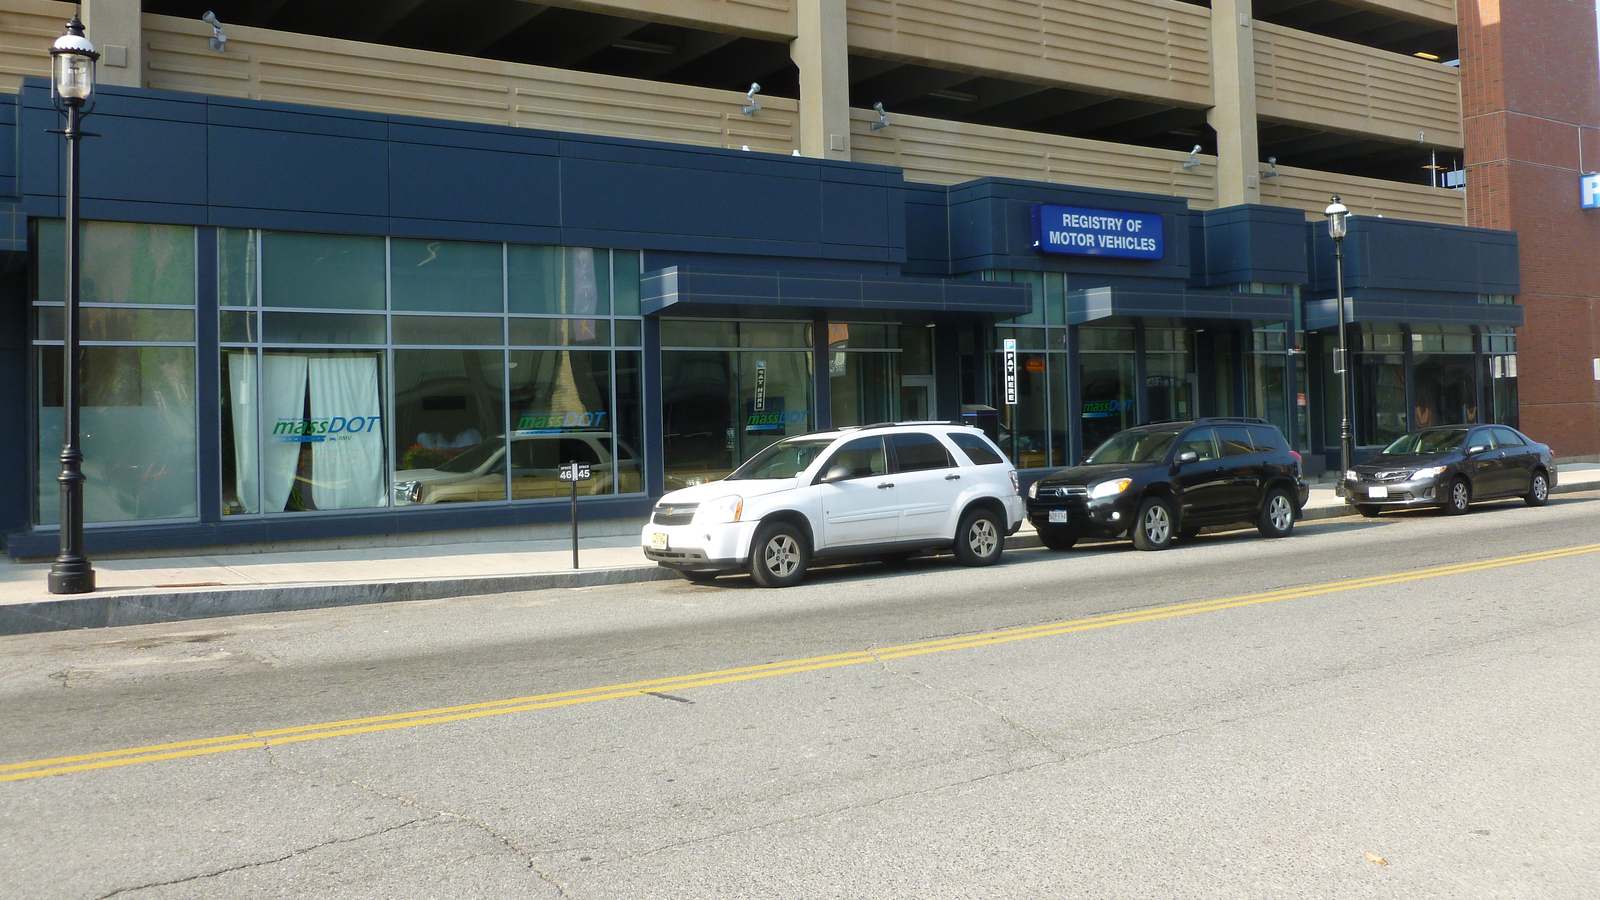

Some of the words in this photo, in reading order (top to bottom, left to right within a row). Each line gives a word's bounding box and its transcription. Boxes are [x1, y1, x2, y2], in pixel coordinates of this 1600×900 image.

[1062, 213, 1122, 231] REGISTRY
[1126, 219, 1143, 232] OF
[1049, 231, 1095, 247] MOTOR
[1098, 235, 1156, 251] VEHICLES
[1007, 375, 1015, 401] HERE
[272, 416, 380, 434] massDOT
[519, 411, 607, 428] massDOT
[560, 470, 571, 479] 46
[579, 469, 590, 478] 45
